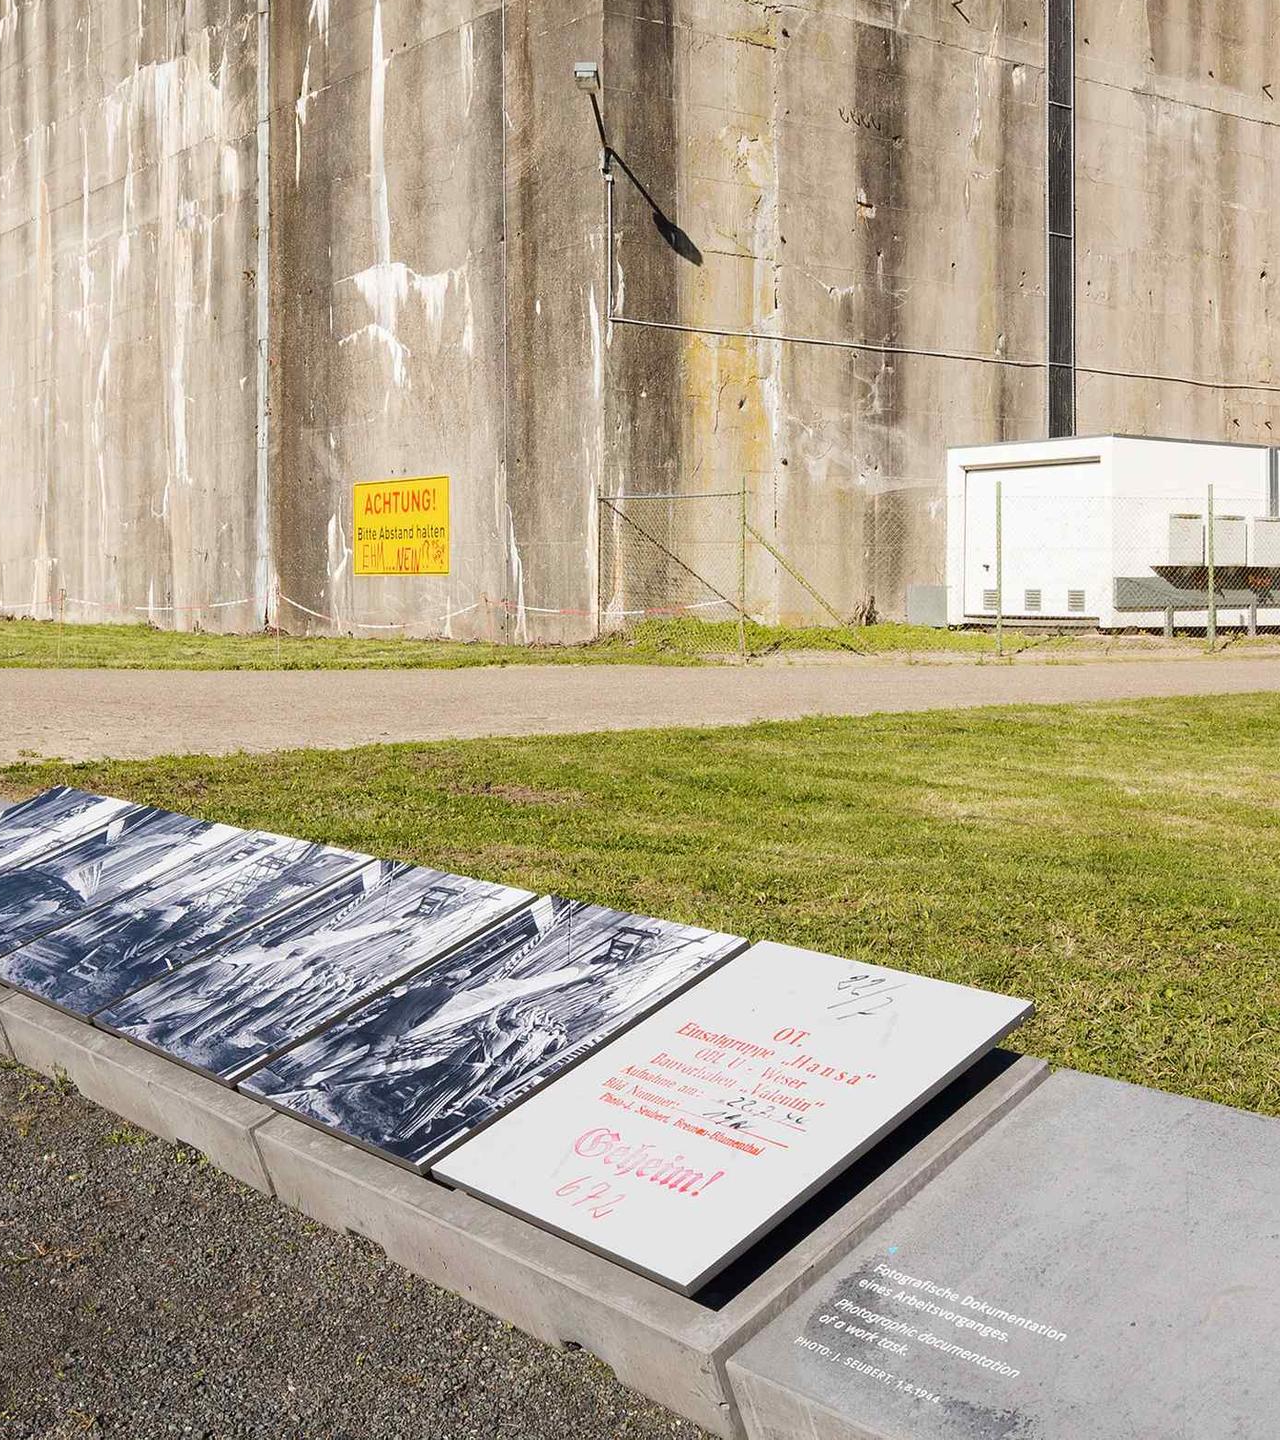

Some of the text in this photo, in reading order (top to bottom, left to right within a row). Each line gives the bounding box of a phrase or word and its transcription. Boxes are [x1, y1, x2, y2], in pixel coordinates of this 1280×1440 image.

[365, 488, 436, 515] ACHTUNG!
[357, 524, 445, 541] Bitte Abstand halten
[773, 1027, 811, 1048] OT.
[621, 1064, 677, 1088] Aufnahme
[650, 1052, 737, 1088] Bauvorhaben
[761, 1065, 807, 1090] Weser
[602, 1076, 629, 1090] Bild
[627, 1085, 680, 1107] Nummer:
[574, 1128, 725, 1197] Geheim!
[859, 1278, 1009, 1343] eines Arbeitsvorganges.
[874, 1264, 1067, 1342] Fotografische Dokumentation
[819, 1314, 909, 1357] of a work task.
[834, 1298, 1020, 1379] Photographic documentation
[794, 1335, 941, 1404] PHOTO: J. SEUBERT, 1.8.1944
